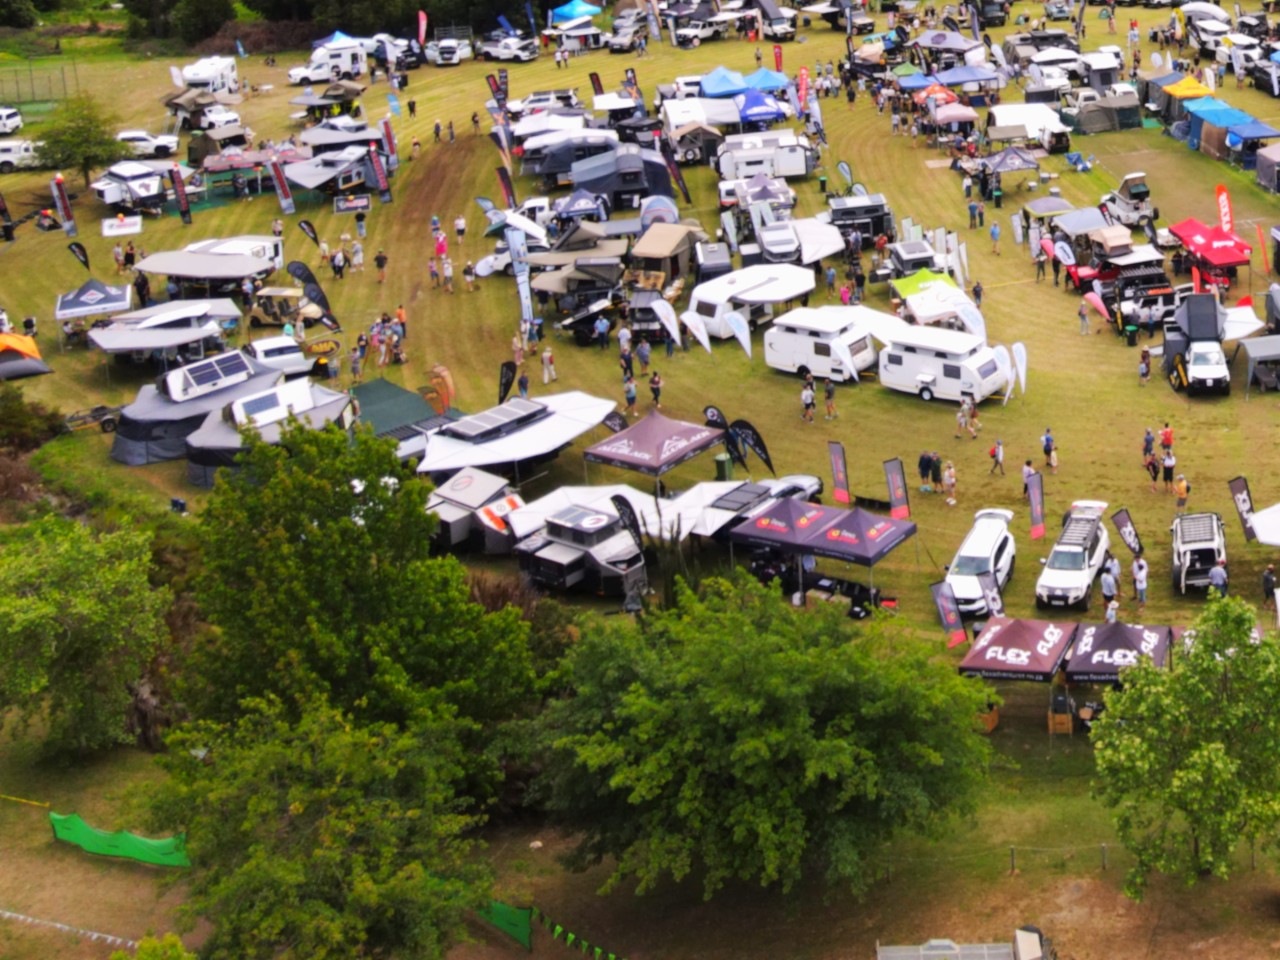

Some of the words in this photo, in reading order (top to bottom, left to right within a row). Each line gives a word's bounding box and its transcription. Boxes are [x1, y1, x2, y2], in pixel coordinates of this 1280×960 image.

[1036, 624, 1062, 656] FLEX
[985, 646, 1031, 663] FLEX
[1092, 649, 1138, 664] FLEX
